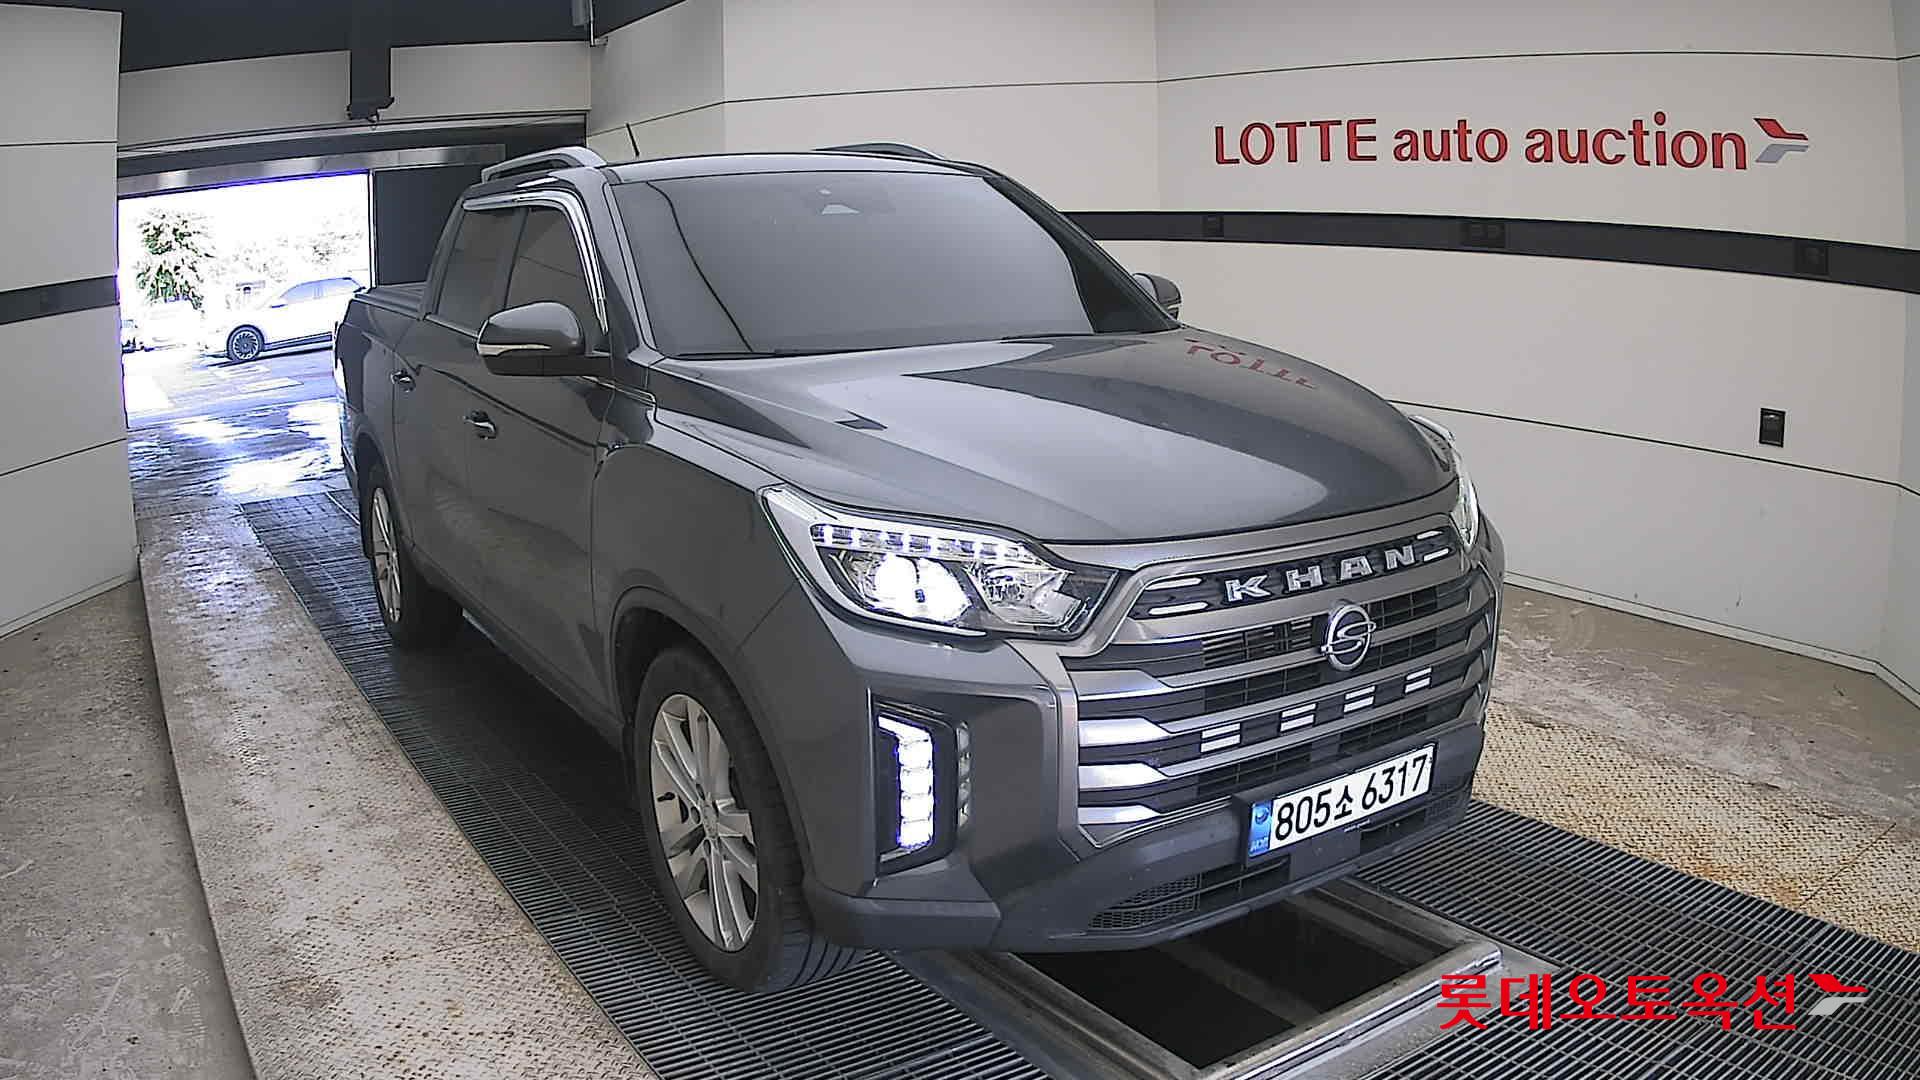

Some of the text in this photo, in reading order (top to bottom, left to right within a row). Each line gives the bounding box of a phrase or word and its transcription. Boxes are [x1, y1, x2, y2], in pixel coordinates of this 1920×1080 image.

[1215, 112, 1747, 170] LOTTE auto auction
[1225, 544, 1416, 602] KHAN
[1275, 754, 1428, 841] 805소 6317
